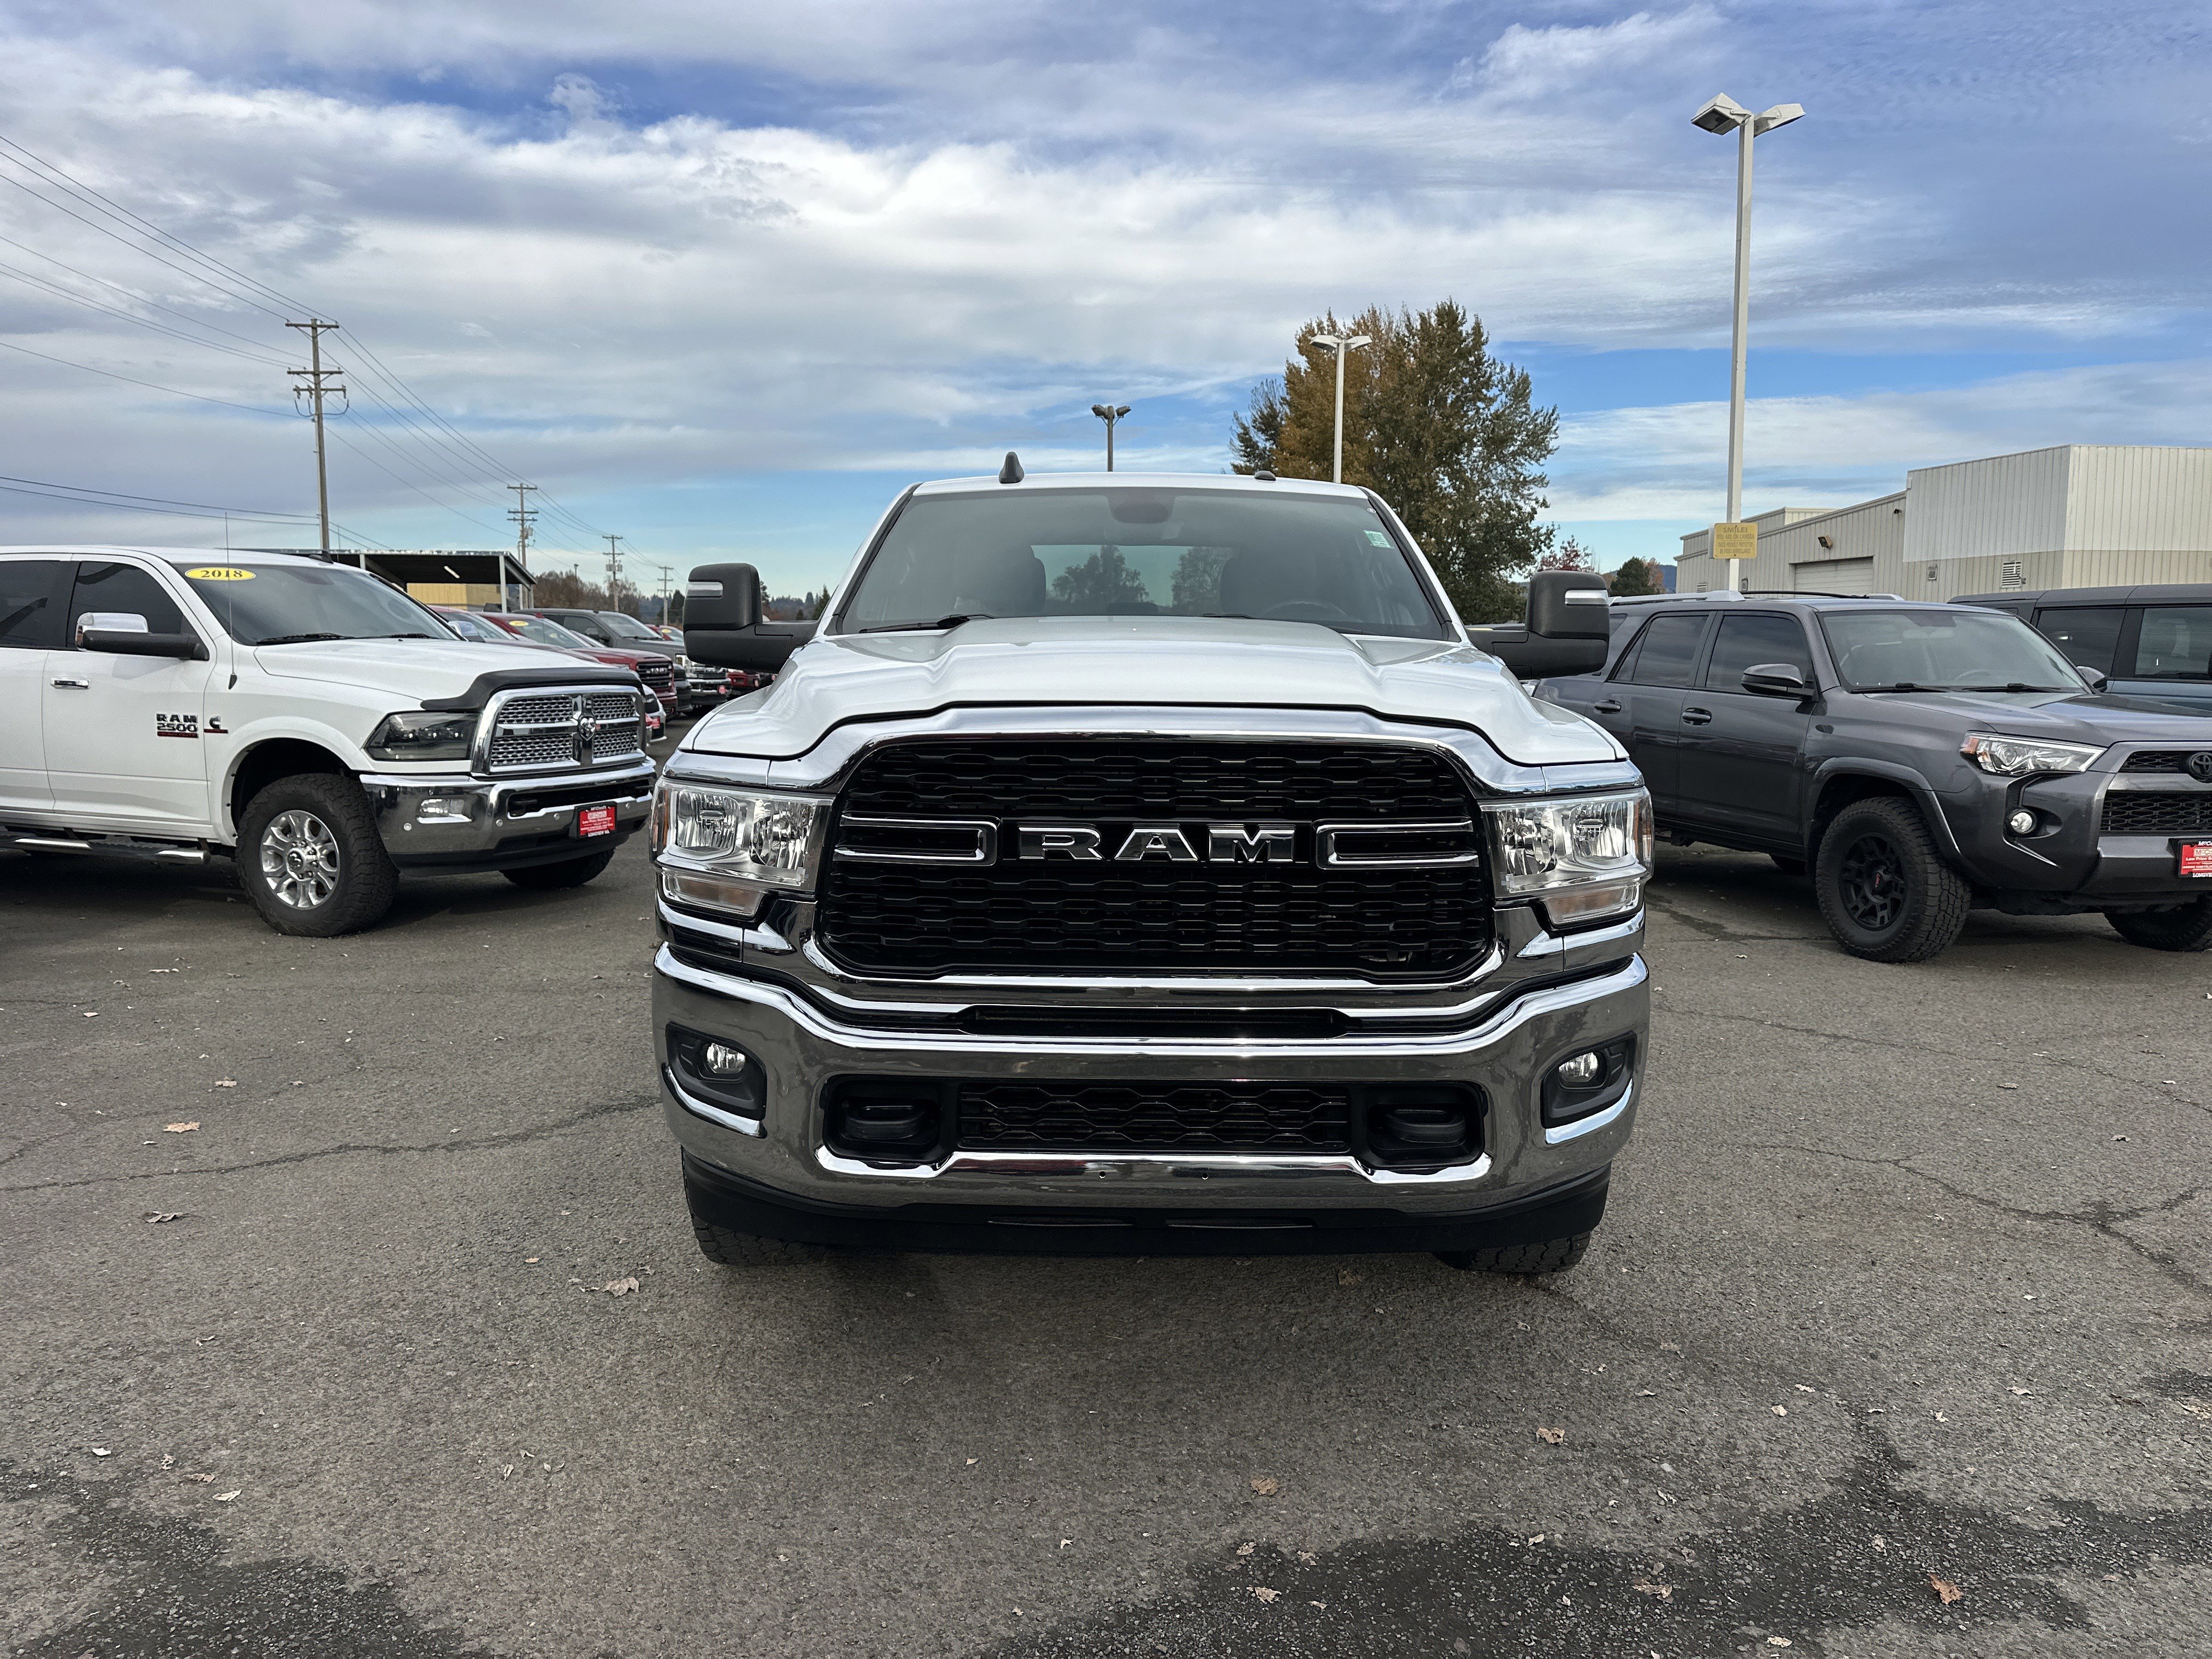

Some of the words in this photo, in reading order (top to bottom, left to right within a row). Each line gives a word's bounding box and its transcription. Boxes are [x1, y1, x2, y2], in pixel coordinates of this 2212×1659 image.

[156, 714, 198, 723] RAM
[157, 723, 198, 732] 2500
[1018, 826, 1295, 862] RAM
